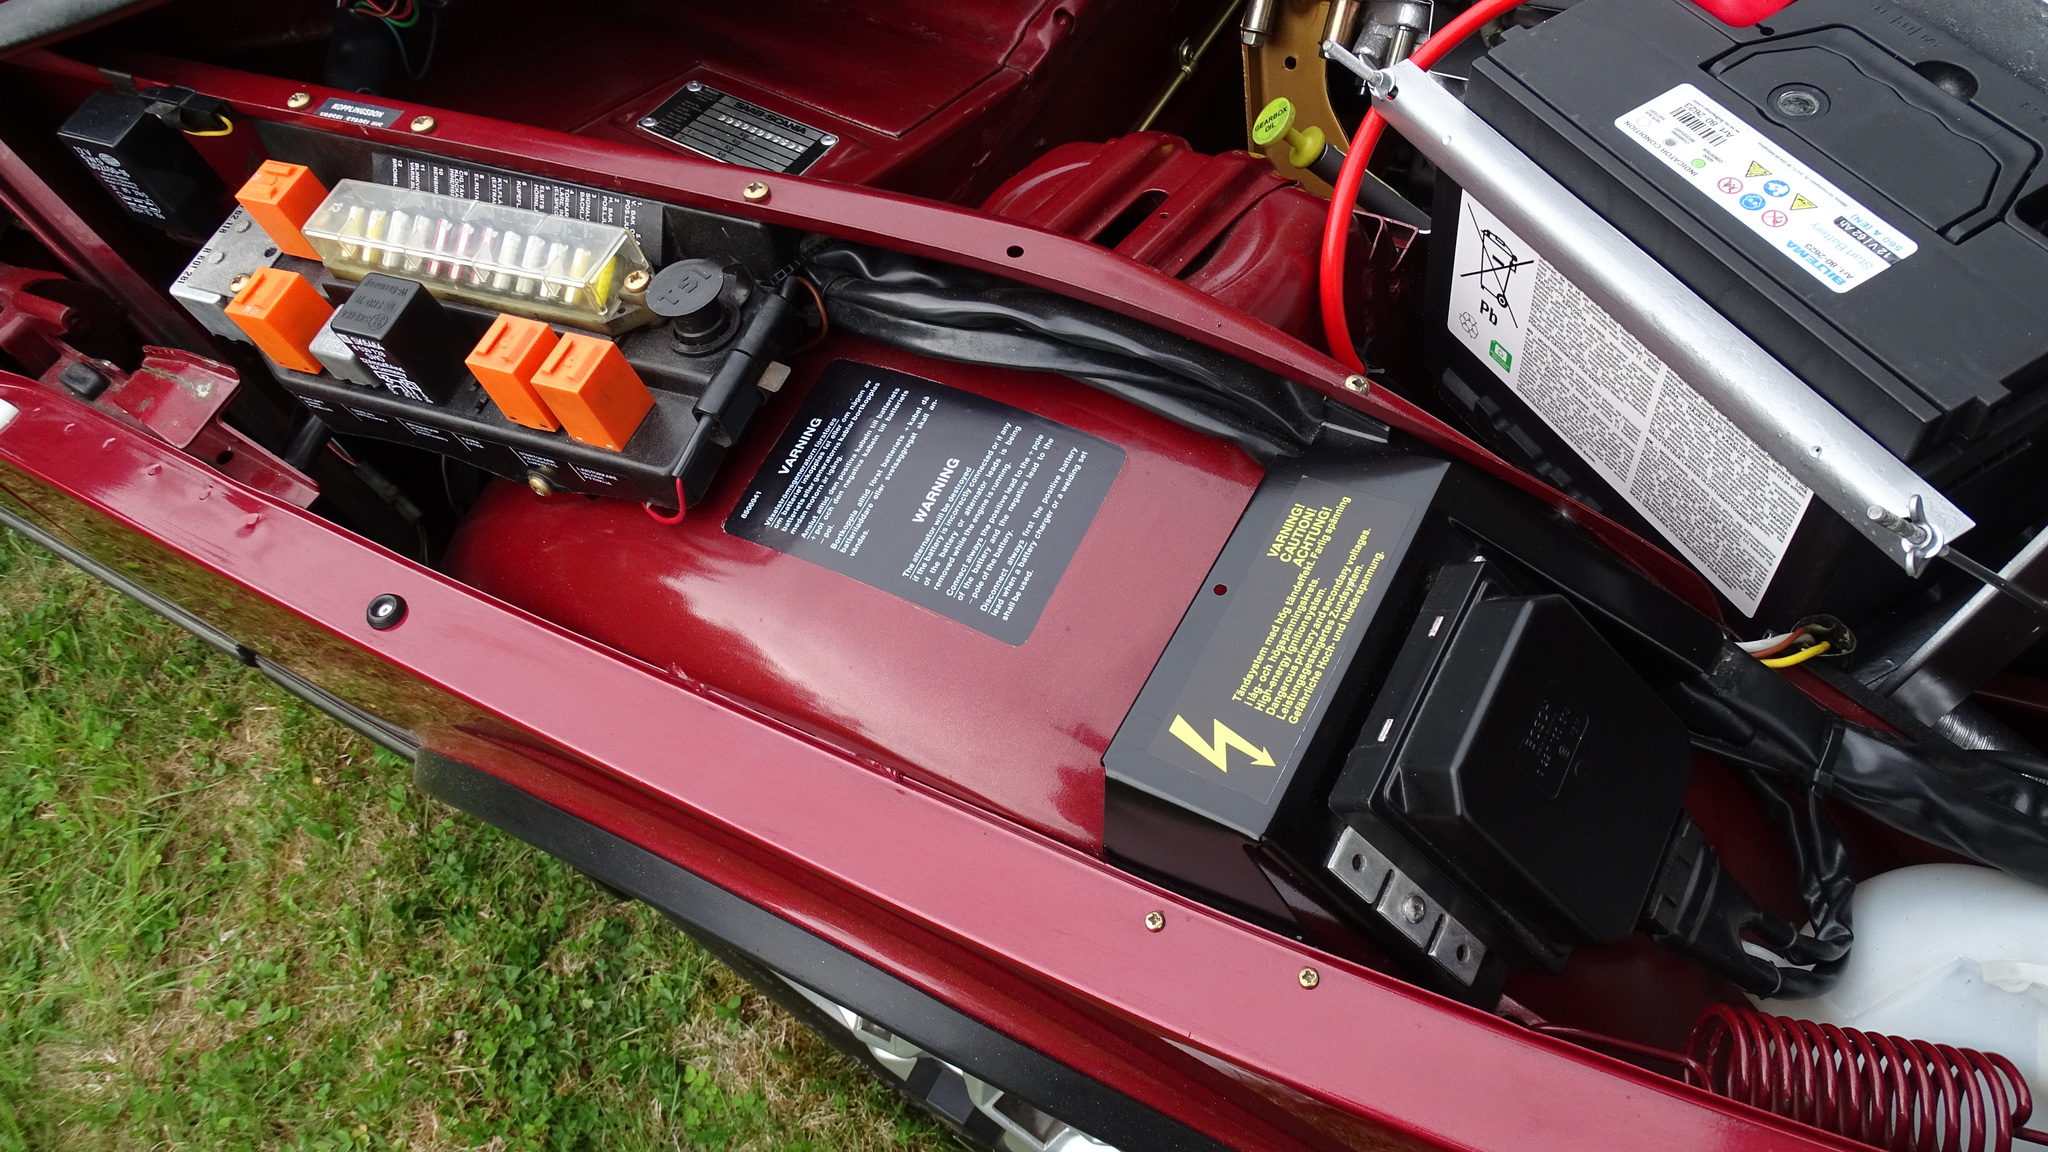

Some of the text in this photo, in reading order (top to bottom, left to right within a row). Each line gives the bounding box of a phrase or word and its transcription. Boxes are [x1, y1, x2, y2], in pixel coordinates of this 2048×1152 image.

[330, 102, 384, 118] KOPPLINGSDON
[732, 101, 808, 134] SAAB-SCANIA
[1254, 106, 1287, 131] GEARBOX
[1264, 122, 1275, 132] OIL
[1623, 120, 1662, 148] CONDITION
[1682, 102, 1734, 138] Art. 80-2623
[1659, 148, 1698, 176] INDICATOR
[1807, 221, 1874, 269] Start Battery
[1837, 219, 1892, 258] 12 V 62 Ah
[1849, 213, 1874, 230] (EN)
[1880, 236, 1903, 251] 560
[1784, 239, 1846, 285] BILTEMA
[1803, 242, 1854, 280] Art. 80-2623
[1480, 300, 1498, 326] Pb
[763, 417, 837, 526] Växelströmsgeneratorn förstöres
[777, 416, 822, 475] VARNING
[800, 387, 900, 538] Anslut alltid den positiva kabeln till batteriets
[830, 509, 860, 549] Bortkoppla
[856, 489, 871, 507] alltid
[868, 469, 883, 486] först
[880, 434, 905, 467] batteriets
[920, 395, 930, 404] då
[839, 398, 939, 552] batteriladdare eller svetsaggregat skall an-
[740, 490, 762, 518] 8506941
[788, 454, 844, 534] medan motorn är igång.
[902, 466, 974, 577] The alternator will be destroyed
[911, 456, 960, 524] WARNING
[915, 561, 928, 574] the
[923, 534, 946, 562] battery
[944, 487, 974, 526] incorrectly
[968, 450, 994, 487] connected
[991, 441, 1000, 449] or
[1000, 422, 1013, 435] any
[922, 576, 932, 585] of
[929, 560, 941, 574] the
[938, 530, 960, 558] battery
[957, 519, 966, 527] or
[963, 480, 988, 515] alternator
[985, 457, 1002, 477] leads
[1005, 425, 1023, 445] being
[931, 556, 955, 590] removed
[951, 536, 968, 556] while
[963, 523, 975, 536] the
[971, 498, 991, 523] engine
[990, 461, 1013, 491] running.
[945, 563, 968, 596] Connect
[964, 536, 986, 563] always
[980, 523, 992, 536] the
[987, 494, 1010, 524] positive
[1004, 477, 1018, 494] lead
[1014, 469, 1023, 478] to
[1019, 456, 1031, 468] the
[979, 446, 1079, 611] Disconnect always first the positive battery
[990, 598, 1005, 616] lead
[1000, 576, 1017, 597] when
[1017, 540, 1039, 568] battery
[1033, 509, 1056, 539] charger
[1052, 500, 1060, 509] or
[1060, 463, 1082, 492] welding
[1076, 450, 1088, 462] set
[1266, 502, 1305, 558] VARNING!
[1278, 506, 1317, 563] CAUTION!
[1291, 505, 1332, 567] ACHTUNG!
[1232, 496, 1352, 703] Tändsystem med hög tändeffekt. Farlig spänning
[1265, 526, 1373, 717] Dangerous primary and secondary voltages.
[1246, 681, 1265, 702] låg-
[1257, 663, 1273, 682] och
[1267, 575, 1322, 663] högspänningskrets.
[1254, 585, 1329, 712] High-energy ignition system.
[1276, 562, 1366, 721] Leistungsgesteigertes Zundsystem.
[1288, 550, 1386, 724] Gefährliche Hoch- und Niederspannung.
